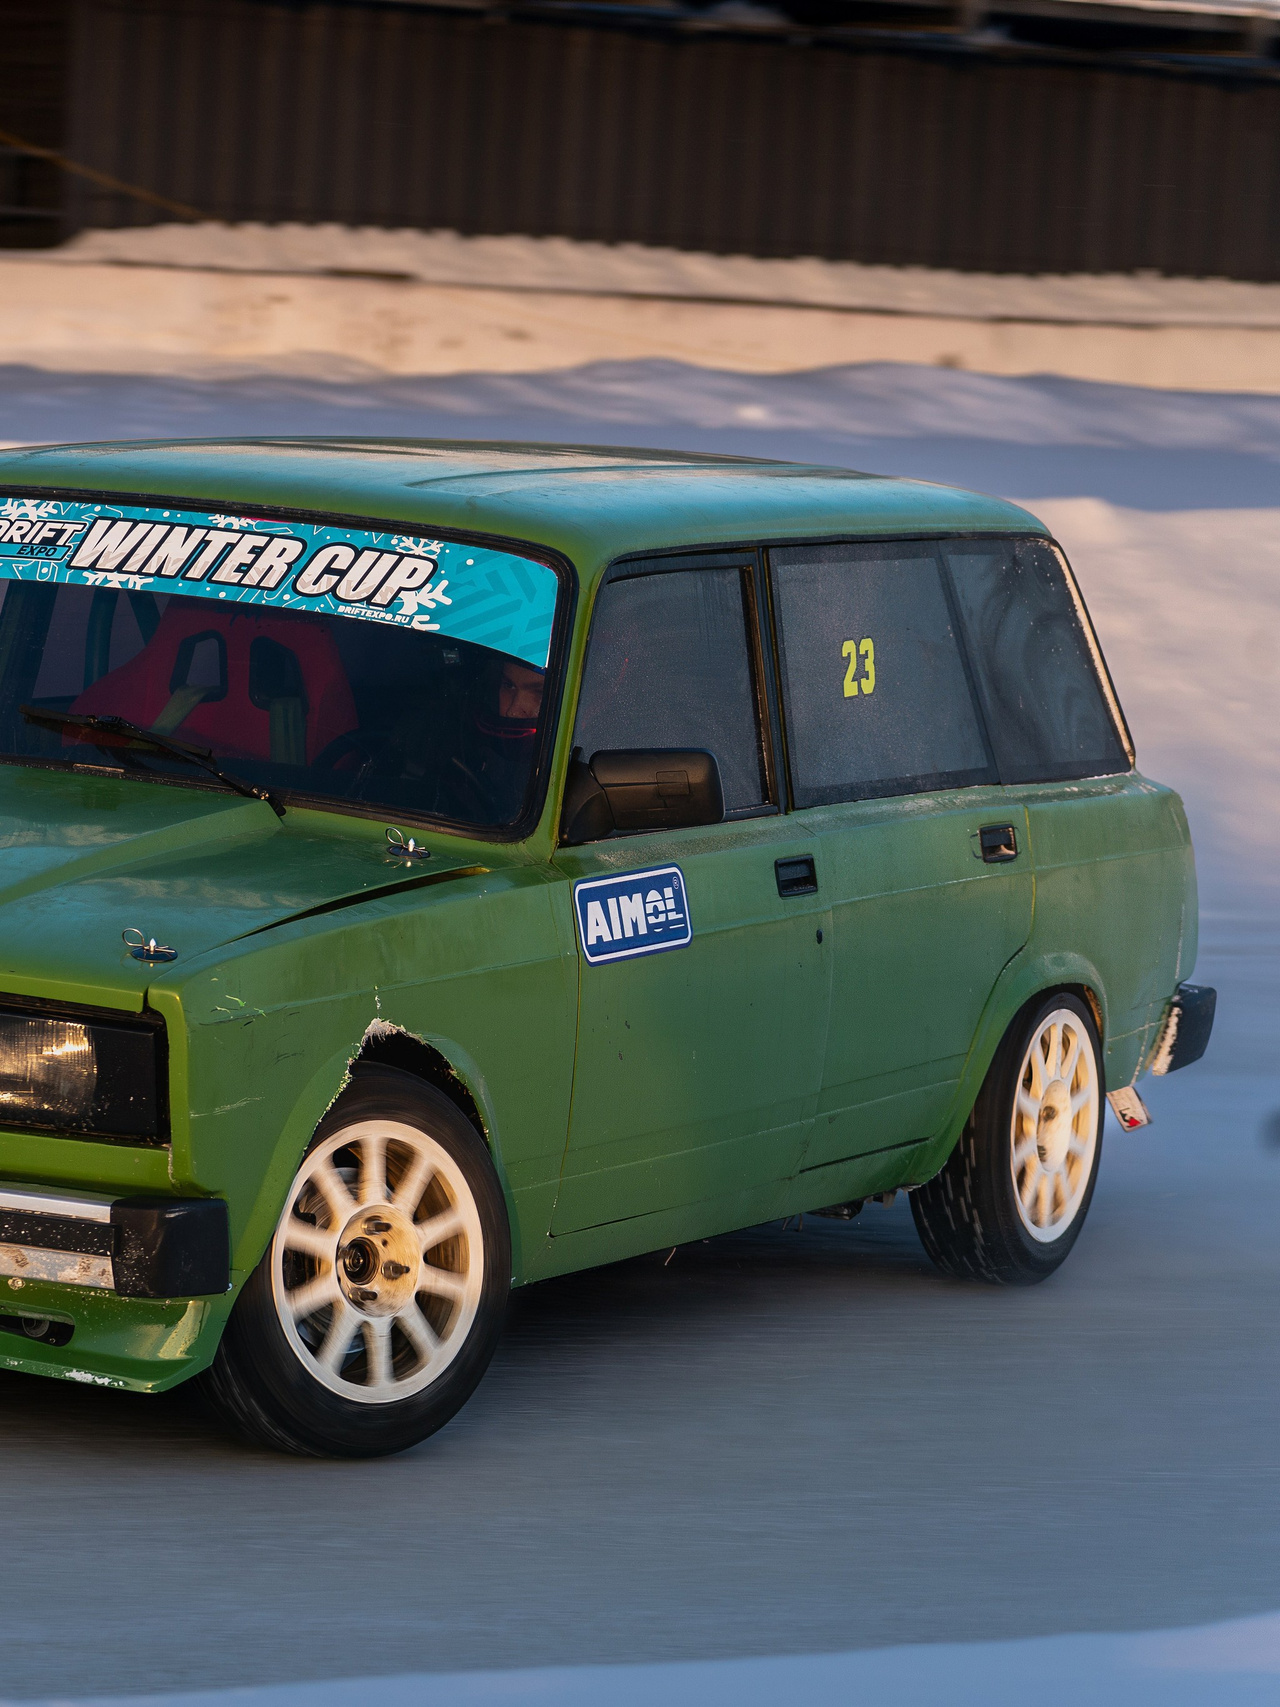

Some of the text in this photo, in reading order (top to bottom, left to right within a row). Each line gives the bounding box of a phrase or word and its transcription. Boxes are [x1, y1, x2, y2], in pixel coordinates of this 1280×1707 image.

[16, 545, 58, 557] EXPO
[69, 518, 435, 605] WINTER CUP
[337, 604, 410, 624] DRIFTEXPO.RU
[841, 637, 876, 698] 23
[587, 886, 685, 946] AIMOL
